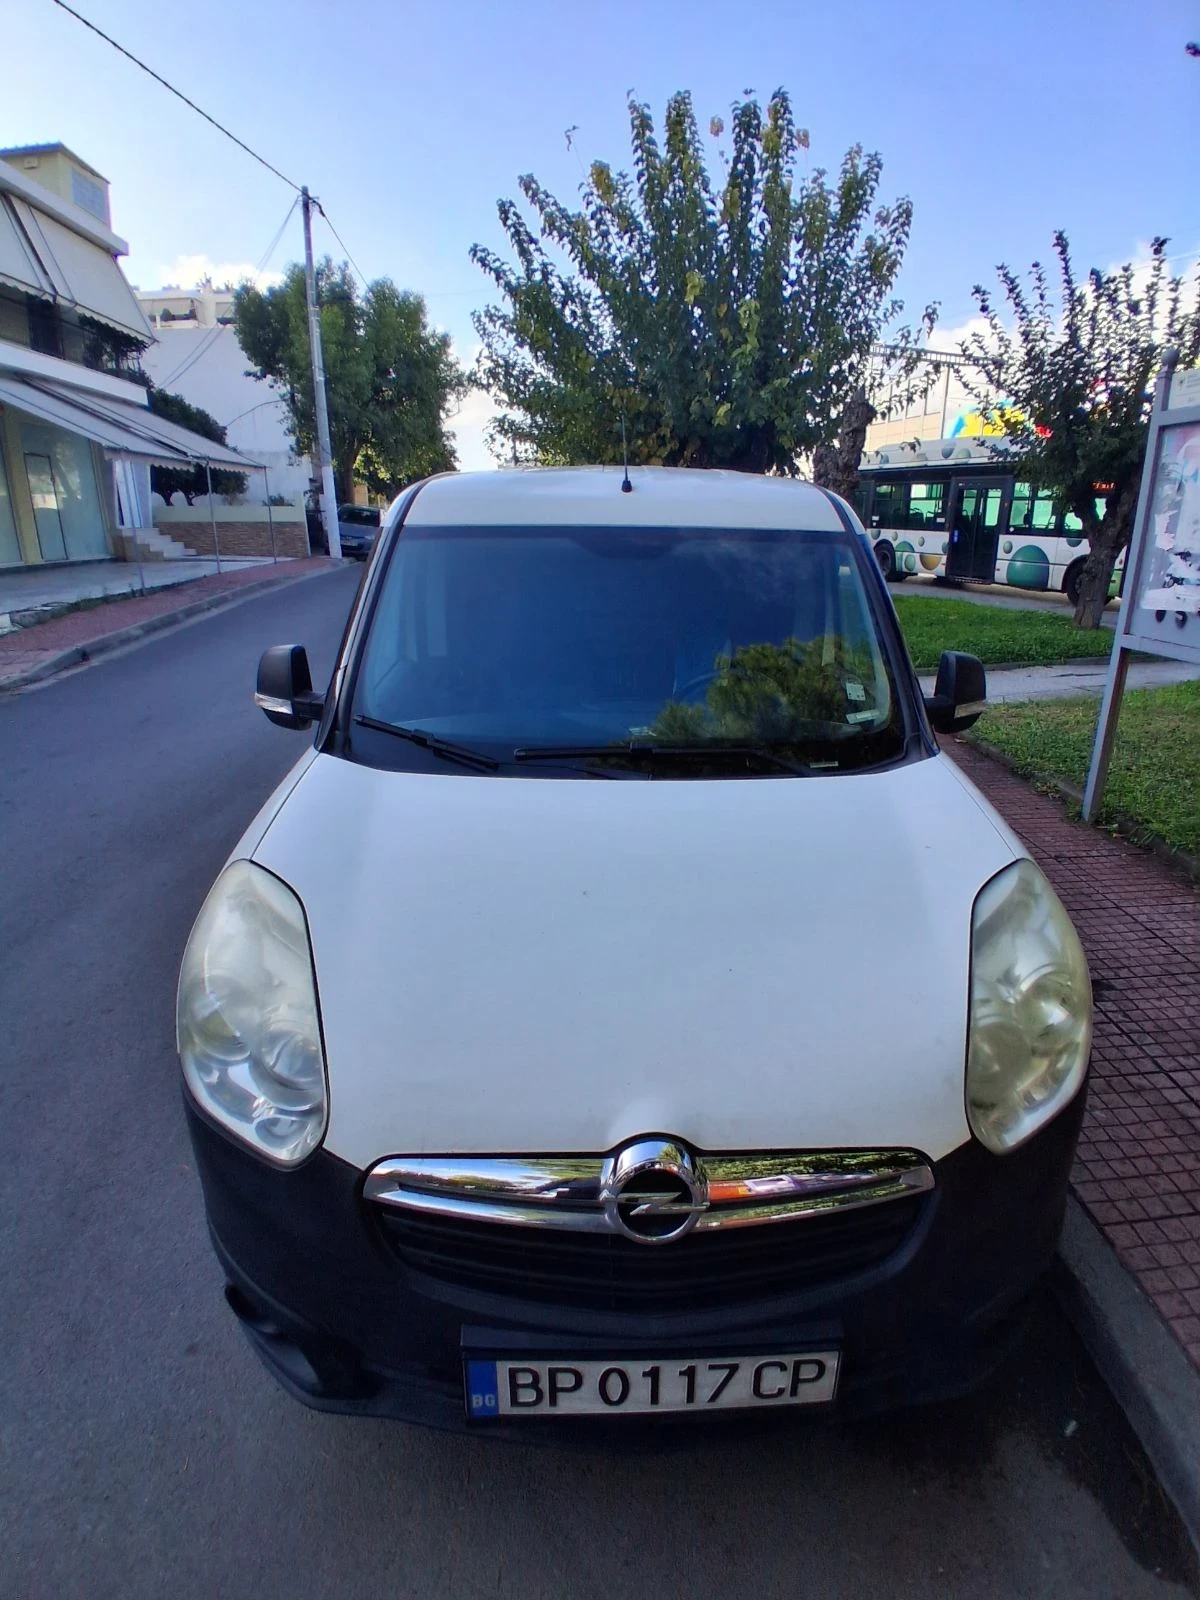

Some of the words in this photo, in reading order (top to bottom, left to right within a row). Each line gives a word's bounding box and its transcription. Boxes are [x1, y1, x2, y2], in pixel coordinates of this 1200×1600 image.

[508, 1366, 583, 1408] BP
[598, 1362, 740, 1407] 0117
[752, 1358, 826, 1400] CP
[471, 1394, 495, 1409] BG
